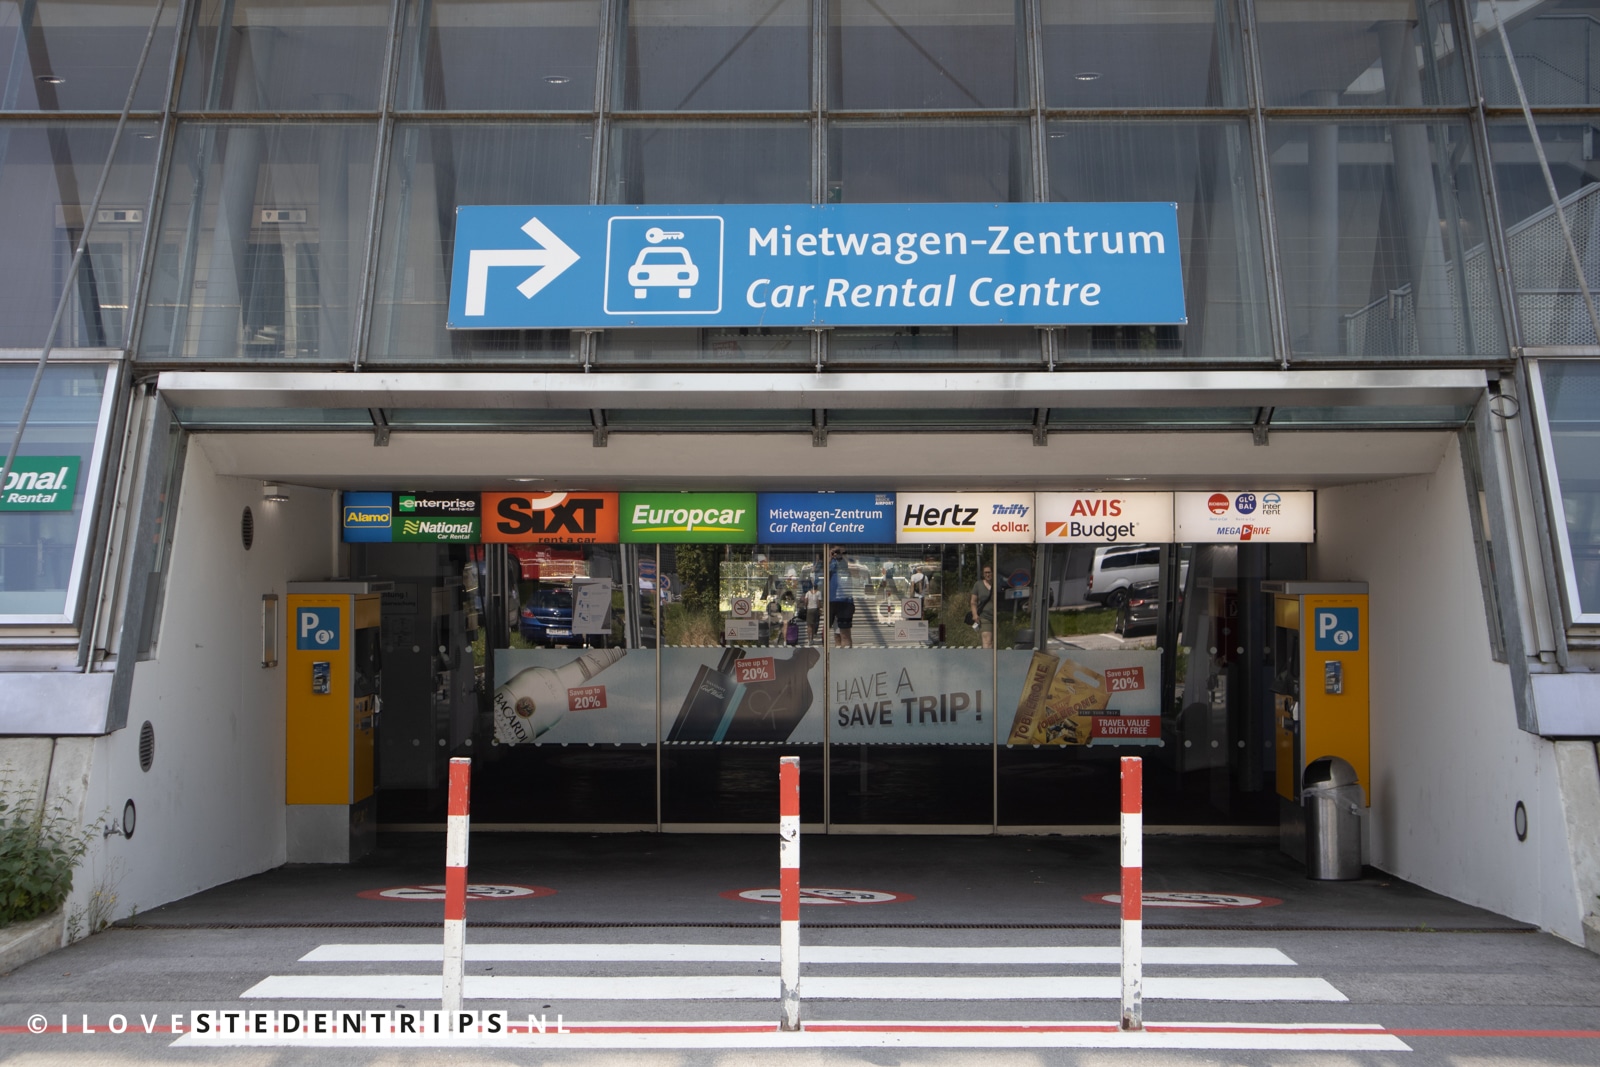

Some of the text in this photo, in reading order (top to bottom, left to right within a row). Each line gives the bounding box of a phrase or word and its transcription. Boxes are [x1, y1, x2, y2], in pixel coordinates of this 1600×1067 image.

[749, 224, 1166, 265] Mietwagen-Zentrum
[746, 273, 1101, 308] Car Rental Centre
[0, 466, 69, 490] onal
[6, 492, 58, 503] Rental
[400, 498, 475, 510] enterprise
[769, 508, 883, 522] Mietwagen-Zentrum
[903, 504, 979, 526] Hertz
[992, 503, 1030, 518] Thrifty
[1070, 499, 1122, 517] AVIS
[347, 512, 389, 522] Alamo
[632, 504, 745, 532] Europcar
[419, 521, 473, 533] National
[769, 521, 865, 533] Car Rental Centre
[991, 522, 1030, 532] dollar.
[1070, 521, 1136, 542] Budget
[301, 612, 320, 638] P
[1319, 613, 1338, 639] P
[737, 660, 751, 668] Save
[742, 667, 769, 681] 20%
[1107, 669, 1121, 678] Save
[1123, 669, 1131, 677] up
[836, 667, 914, 702] HAVE A
[1112, 677, 1139, 690] 20%
[569, 688, 584, 696] Save
[585, 688, 593, 696] up
[574, 695, 601, 709] 20%
[1014, 663, 1050, 740] TOBLERONE
[493, 692, 529, 743] BACARDI
[838, 700, 893, 727] SAVE
[1098, 718, 1150, 727] TRAVEL VALUE
[1101, 726, 1148, 735] & DUTY FREE
